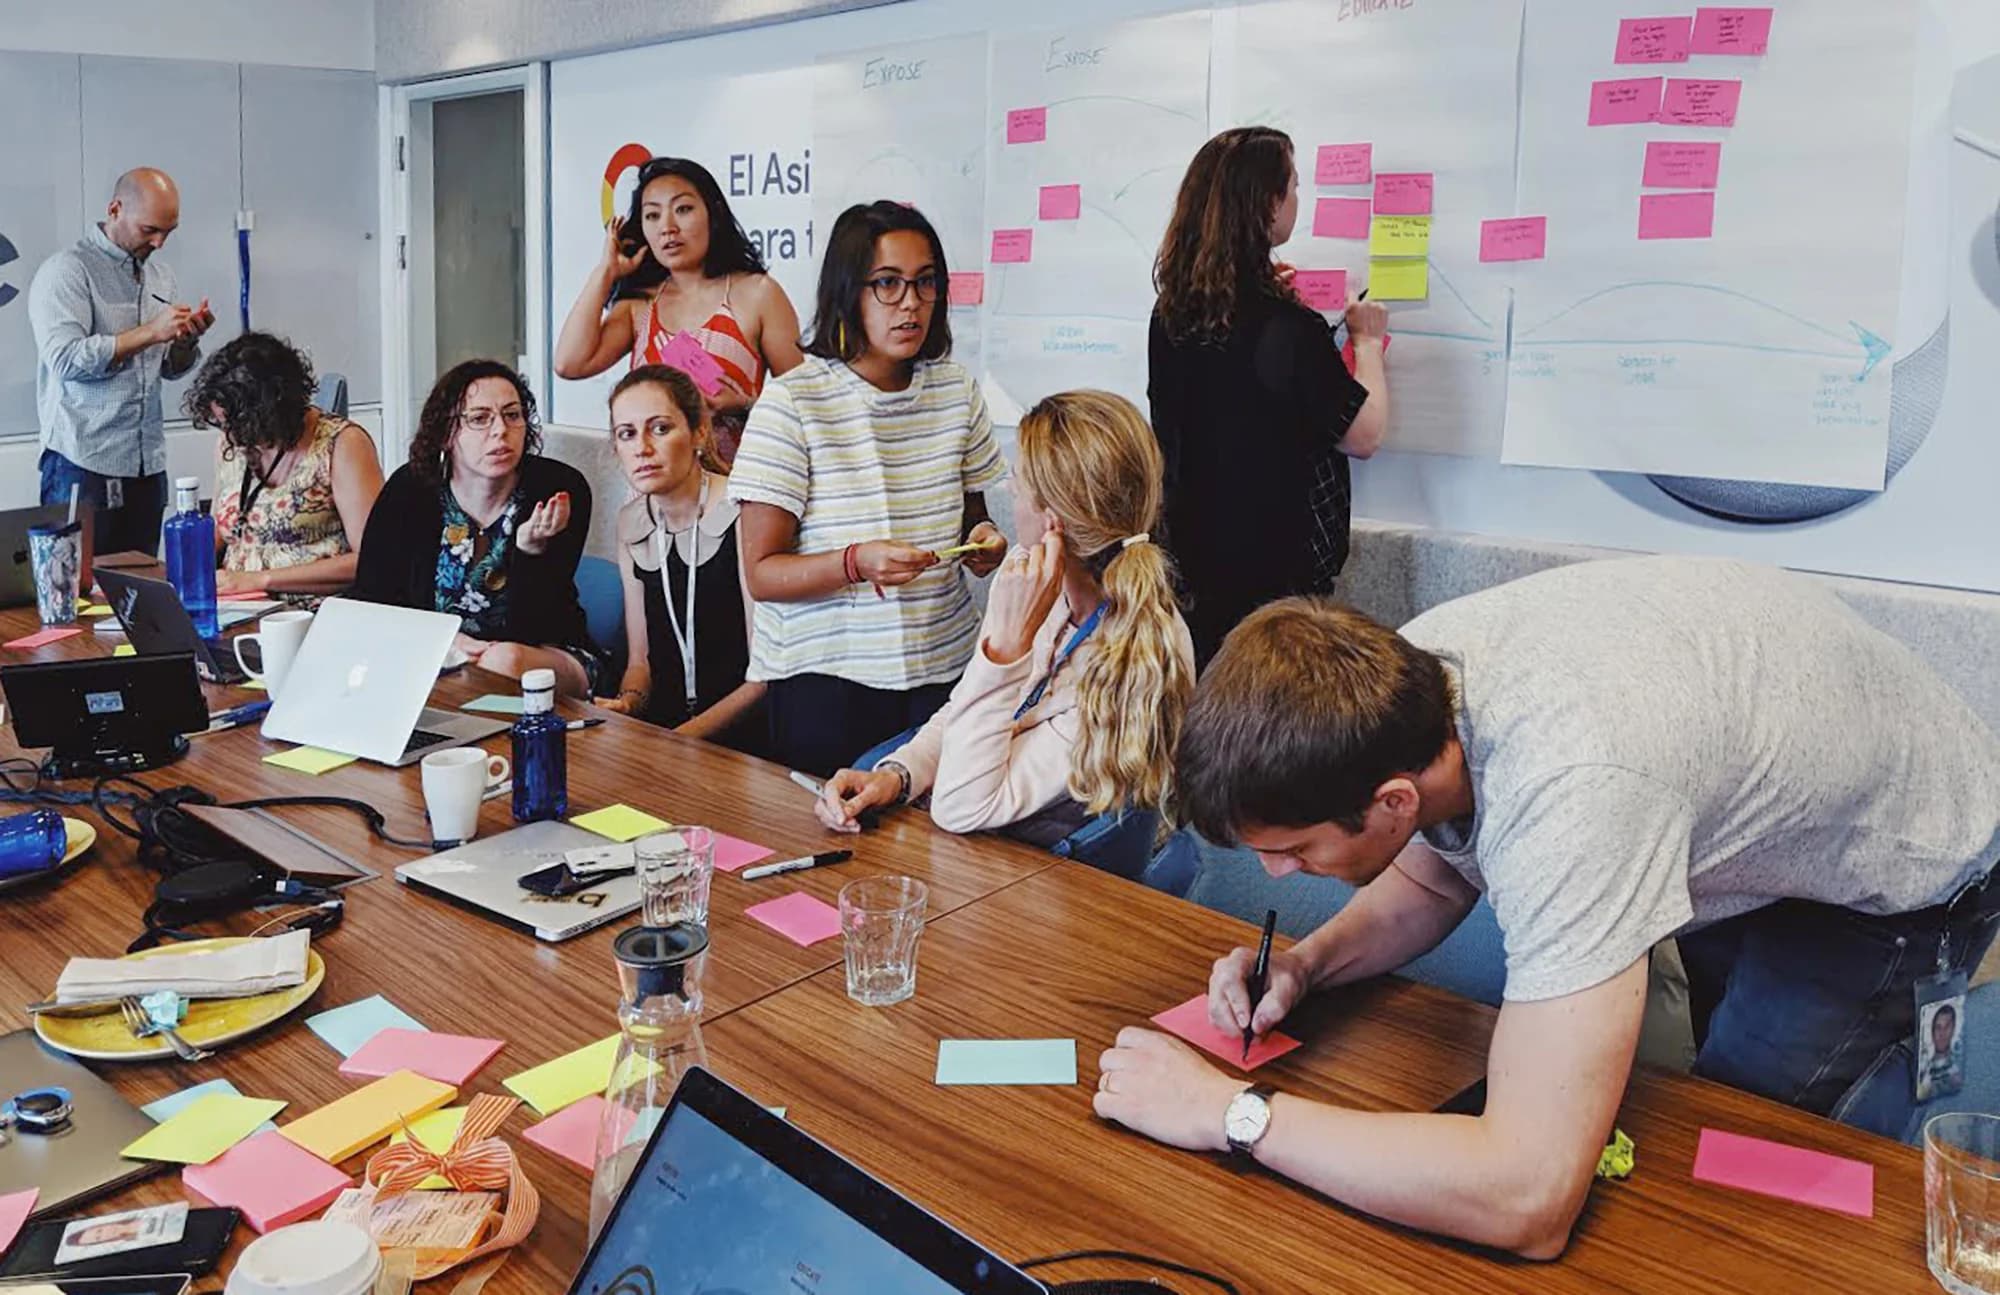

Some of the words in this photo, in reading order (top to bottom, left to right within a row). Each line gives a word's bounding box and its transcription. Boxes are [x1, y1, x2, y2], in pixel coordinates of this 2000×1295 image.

[730, 154, 753, 196] El
[762, 149, 811, 195] Asi
[748, 228, 796, 259] ara
